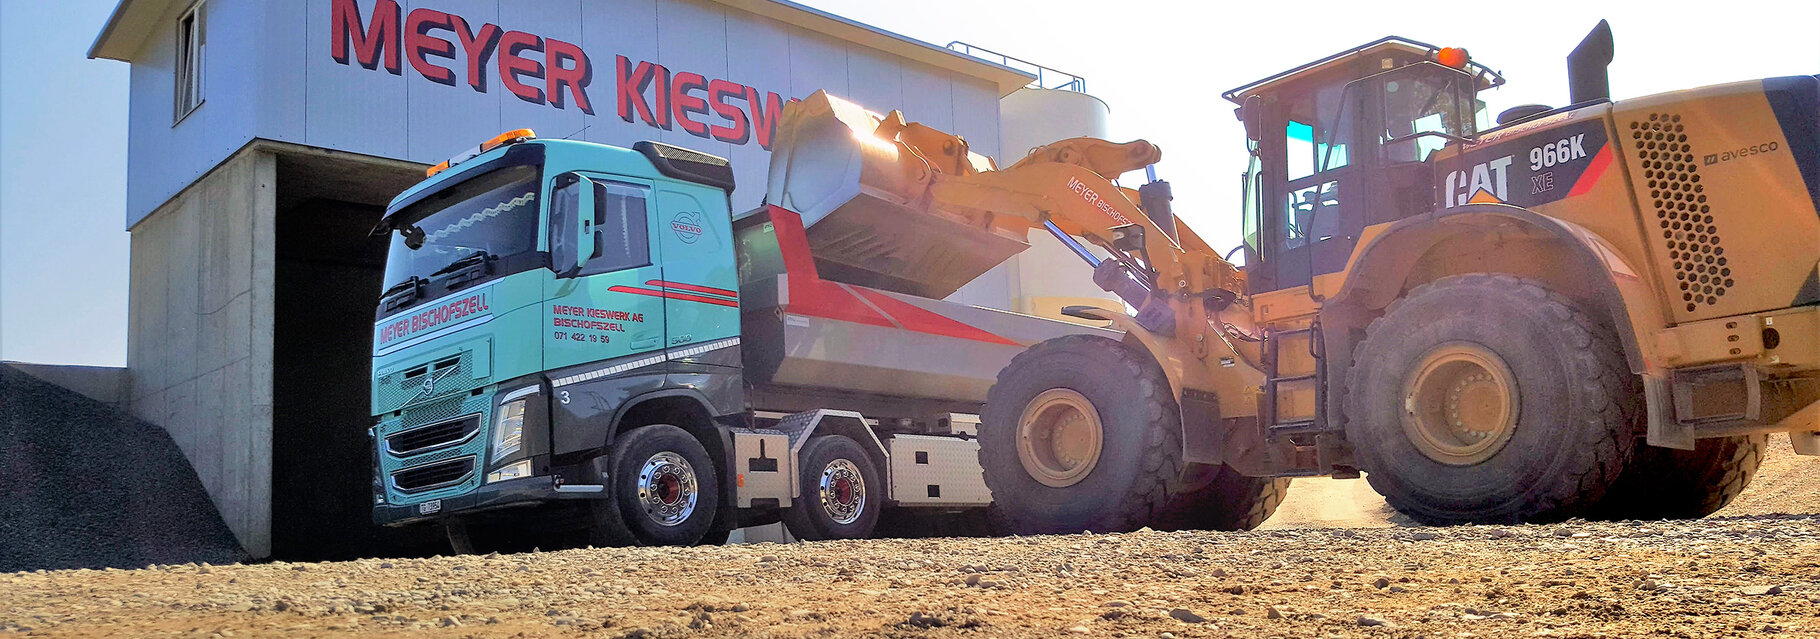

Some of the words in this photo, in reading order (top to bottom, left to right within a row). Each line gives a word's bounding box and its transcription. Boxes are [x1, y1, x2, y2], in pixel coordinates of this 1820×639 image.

[331, 0, 595, 116] MEYER
[1529, 133, 1587, 172] 966K
[1721, 141, 1778, 161] avesco
[1067, 176, 1099, 205] MEYER
[1445, 155, 1512, 208] CAT
[1531, 172, 1554, 195] XE
[672, 222, 702, 234] VOLVO
[380, 319, 410, 344] MEYER
[412, 293, 489, 333] BISCHOFSZELL
[553, 304, 585, 317] MEYER
[587, 308, 631, 321] KIESWERK
[632, 313, 644, 323] AG
[554, 317, 626, 332] BISCHOFSZELL
[554, 331, 568, 341] 071
[571, 333, 586, 342] 422
[600, 335, 610, 343] 59
[561, 390, 571, 404] 3
